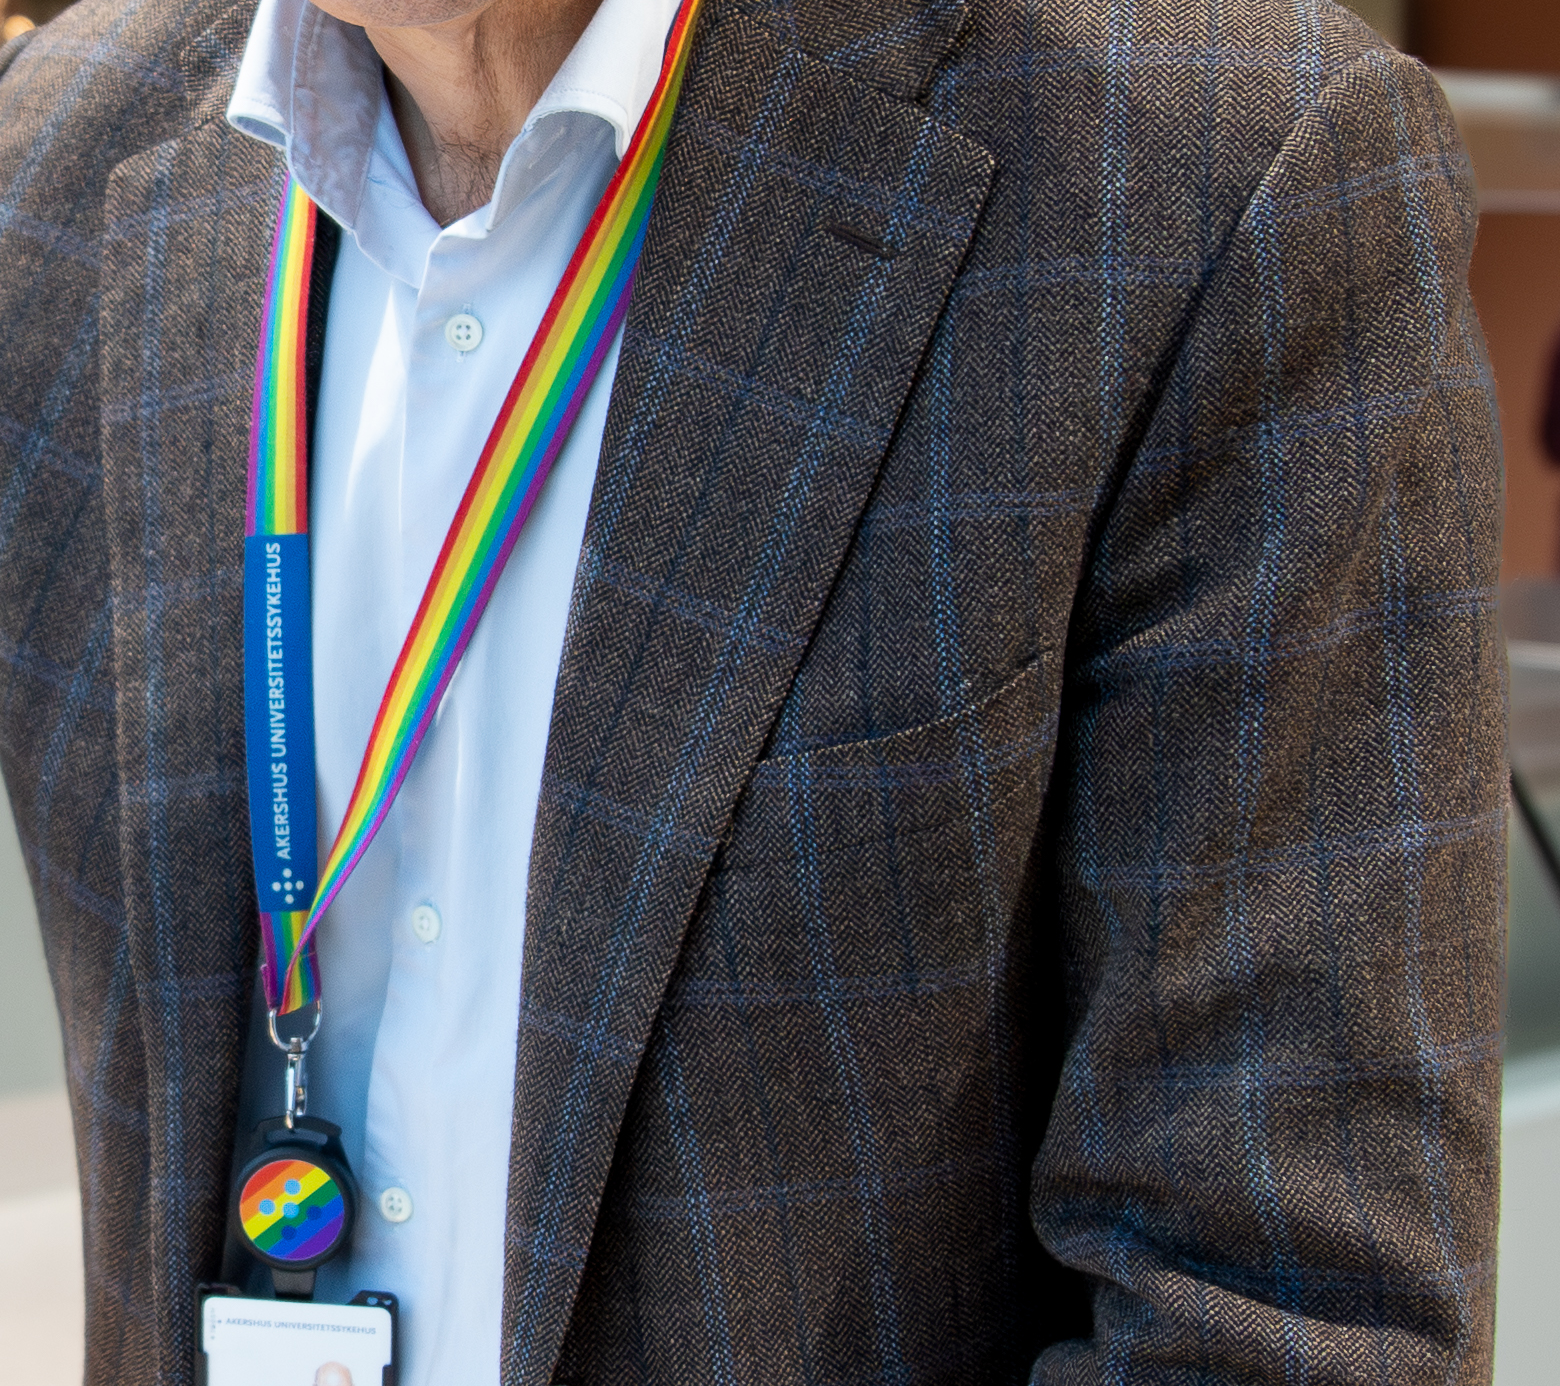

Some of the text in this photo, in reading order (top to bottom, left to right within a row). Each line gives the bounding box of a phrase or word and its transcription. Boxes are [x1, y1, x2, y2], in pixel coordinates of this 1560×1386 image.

[266, 542, 291, 860] AKERSHUS UNIVERSITETSSYKEHUS
[225, 1317, 377, 1335] AKERSHUS UNIVERSITETSSYKEHUS
